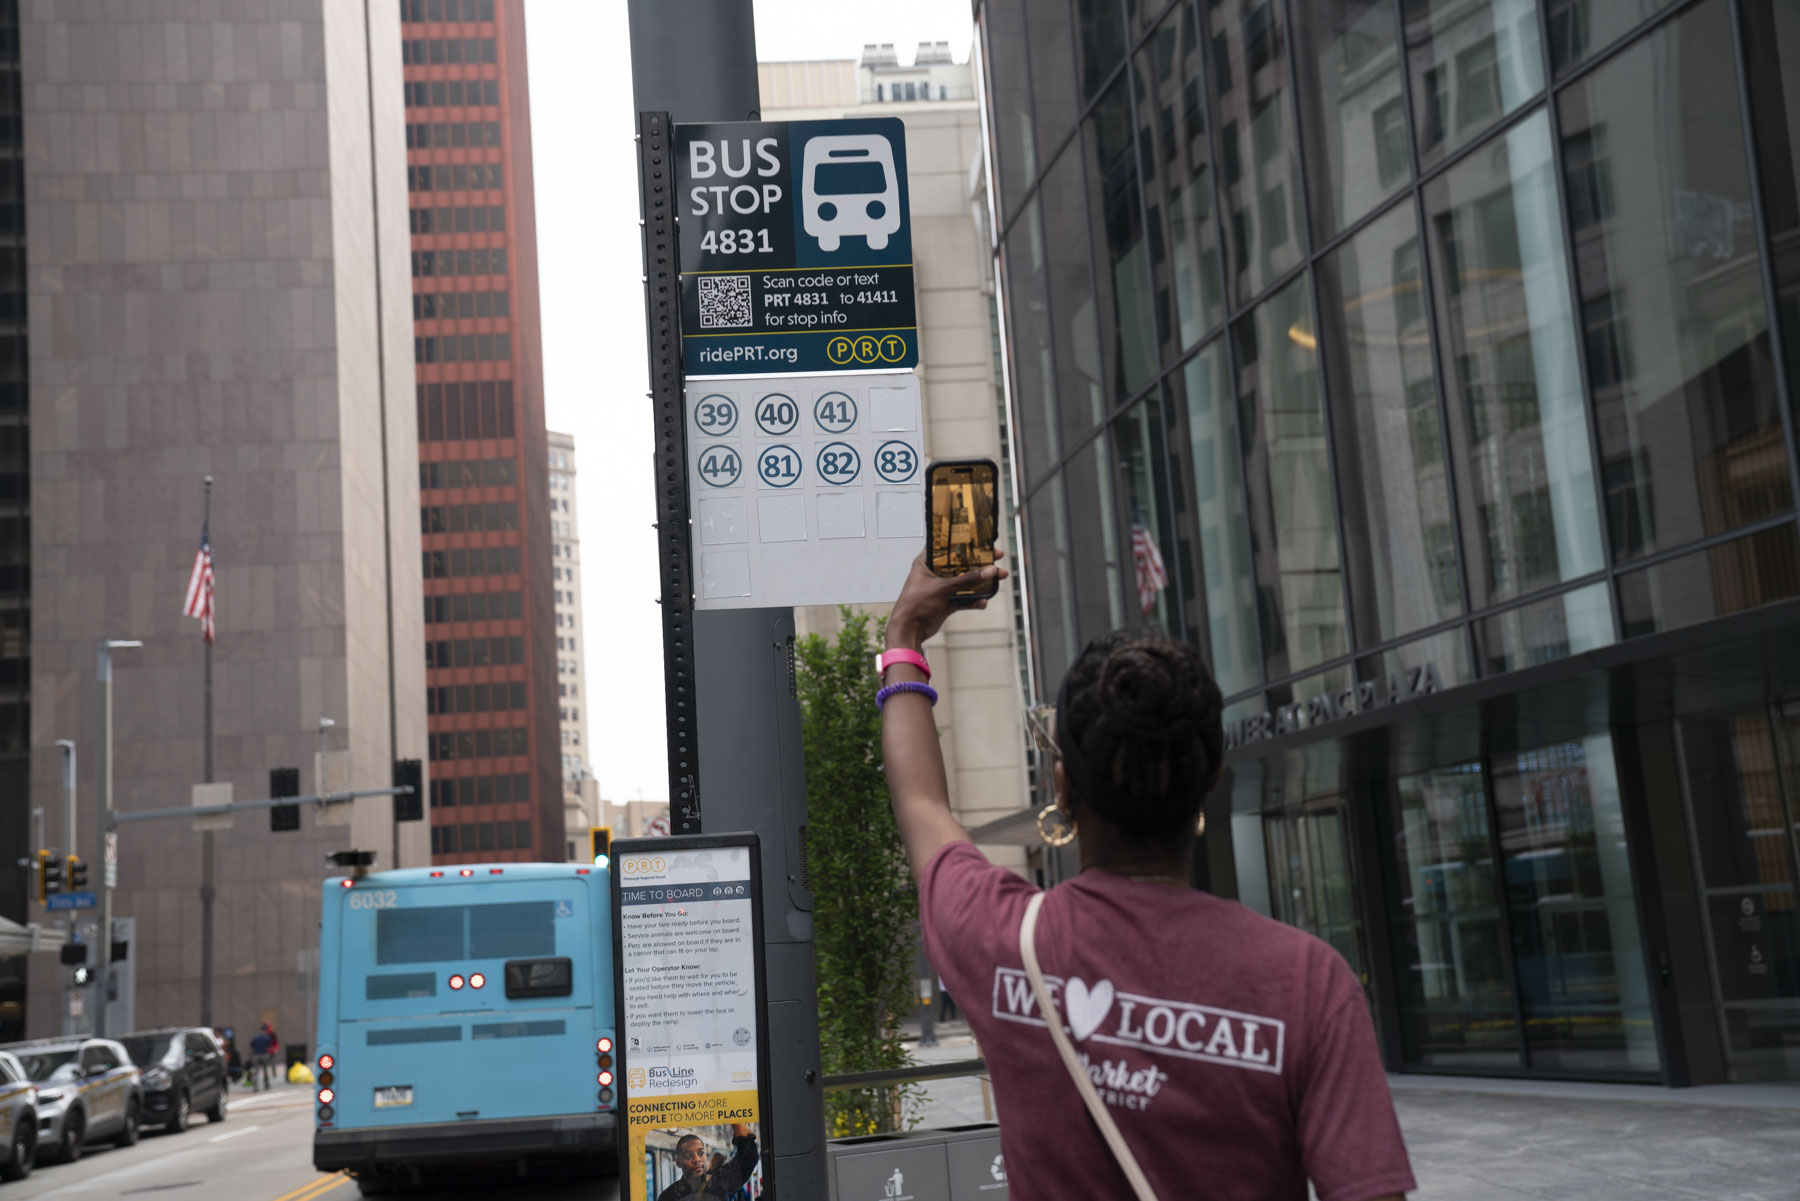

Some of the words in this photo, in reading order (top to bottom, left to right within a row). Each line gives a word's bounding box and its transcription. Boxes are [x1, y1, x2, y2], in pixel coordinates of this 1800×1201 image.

[689, 138, 780, 180] BUS
[690, 184, 782, 216] STOP
[700, 229, 773, 254] 4831
[763, 275, 794, 288] Scan
[798, 274, 833, 287] code
[837, 276, 851, 286] or
[854, 273, 879, 285] text
[765, 294, 791, 307] PRT
[794, 292, 828, 305] 4831
[840, 292, 854, 304] to
[857, 290, 898, 303] 41411
[765, 312, 784, 326] for
[788, 313, 817, 328] stop
[821, 310, 847, 323] info
[700, 346, 798, 362] ridePRT.org
[701, 404, 733, 426] 39
[760, 403, 794, 425] 40
[820, 401, 851, 424] 41
[703, 455, 737, 478] 44
[764, 455, 796, 478] 81
[823, 452, 854, 475] 82
[881, 451, 912, 473] 83
[1358, 662, 1444, 711] PLAZA
[350, 891, 396, 910] 6032
[622, 891, 646, 901] TIME
[649, 890, 663, 899] TO
[667, 888, 703, 898] BOARD
[1117, 1000, 1270, 1064] LOCAL
[649, 1068, 666, 1077] Bus
[672, 1067, 694, 1076] Line
[649, 1079, 697, 1088] Redesign
[630, 1101, 695, 1113] CONNECTING
[699, 1099, 727, 1108] MORE
[630, 1115, 666, 1125] PEOPLE
[669, 1113, 682, 1122] TO
[686, 1111, 714, 1120] MORE
[718, 1109, 753, 1118] PLACES
